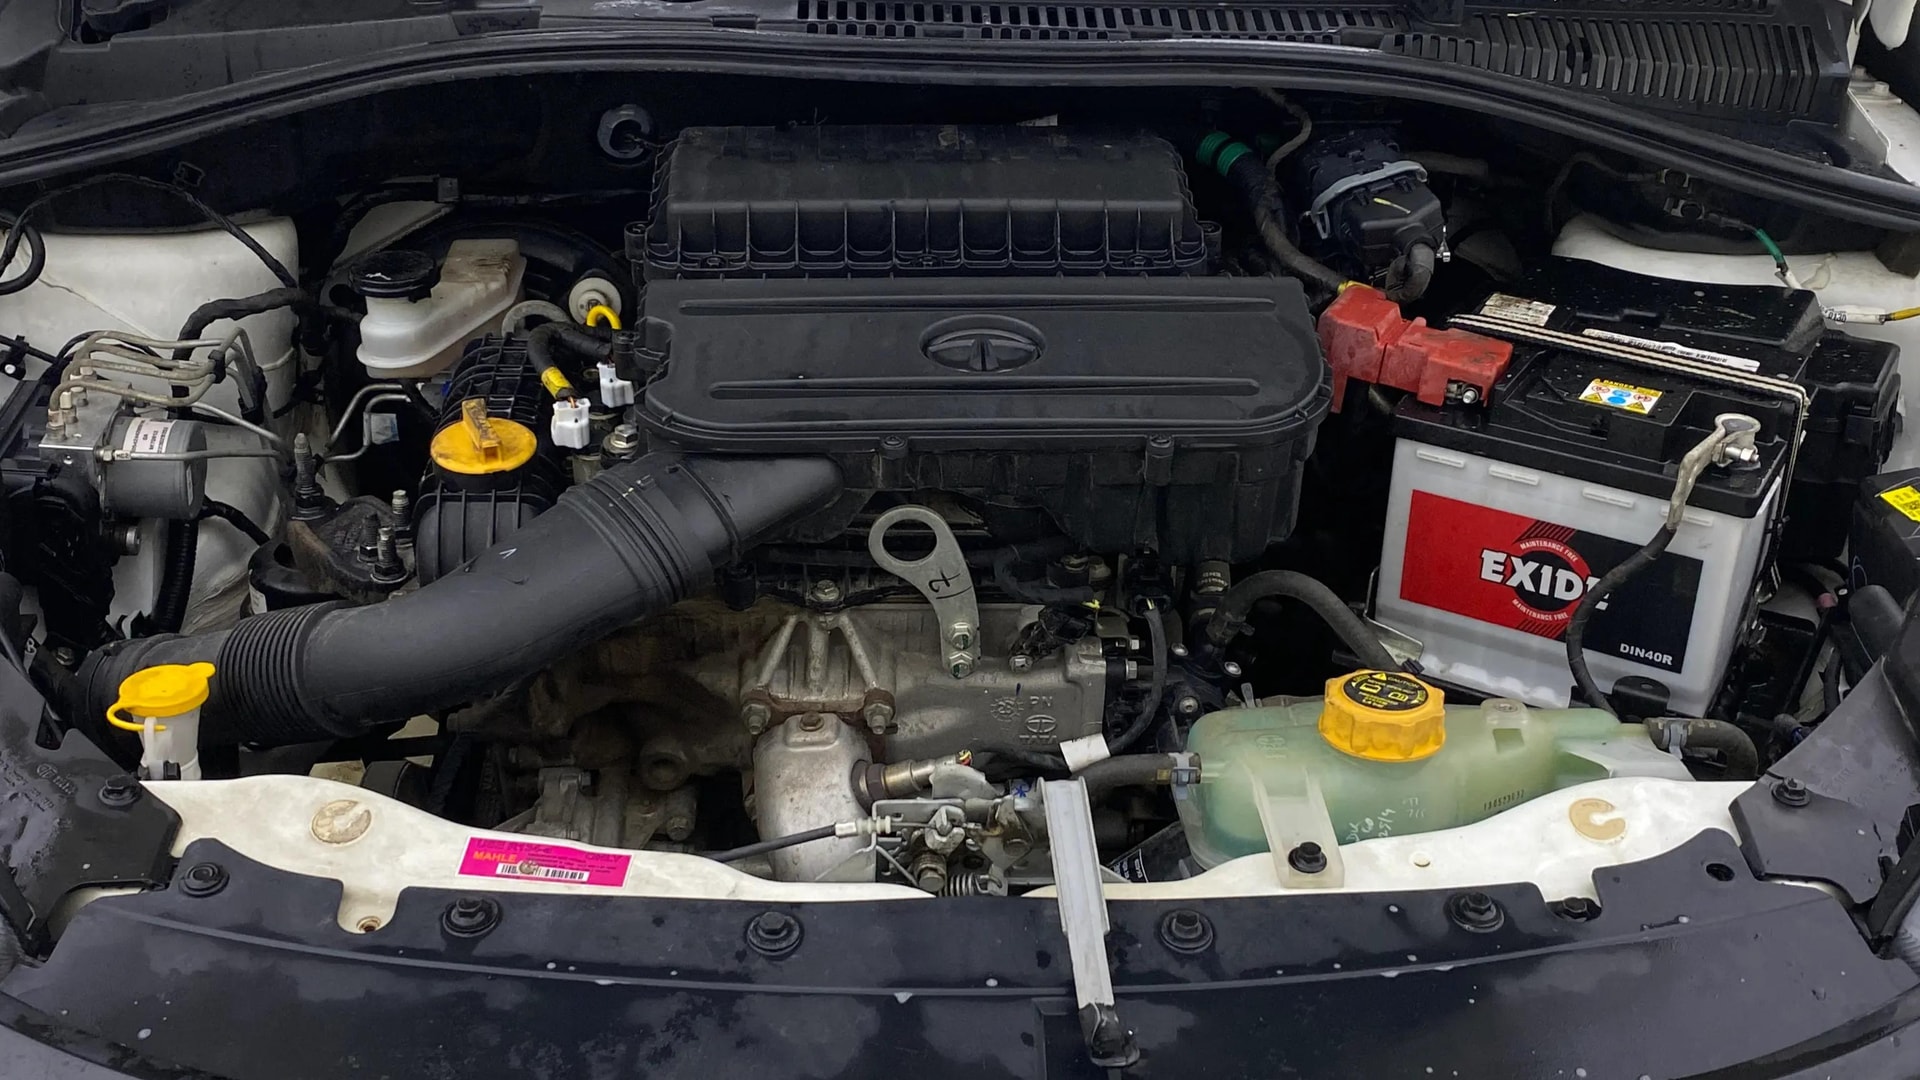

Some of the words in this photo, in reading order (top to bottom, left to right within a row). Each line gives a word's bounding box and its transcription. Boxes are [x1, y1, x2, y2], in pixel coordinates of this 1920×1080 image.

[1520, 540, 1564, 552] MAINTENANCE
[1564, 547, 1579, 563] FREE
[1512, 598, 1553, 621] MAINTENANCE
[1553, 611, 1569, 621] FREE
[1620, 642, 1673, 666] DIN40R
[1387, 676, 1420, 689] CAUTION
[472, 851, 517, 862] MAHLE
